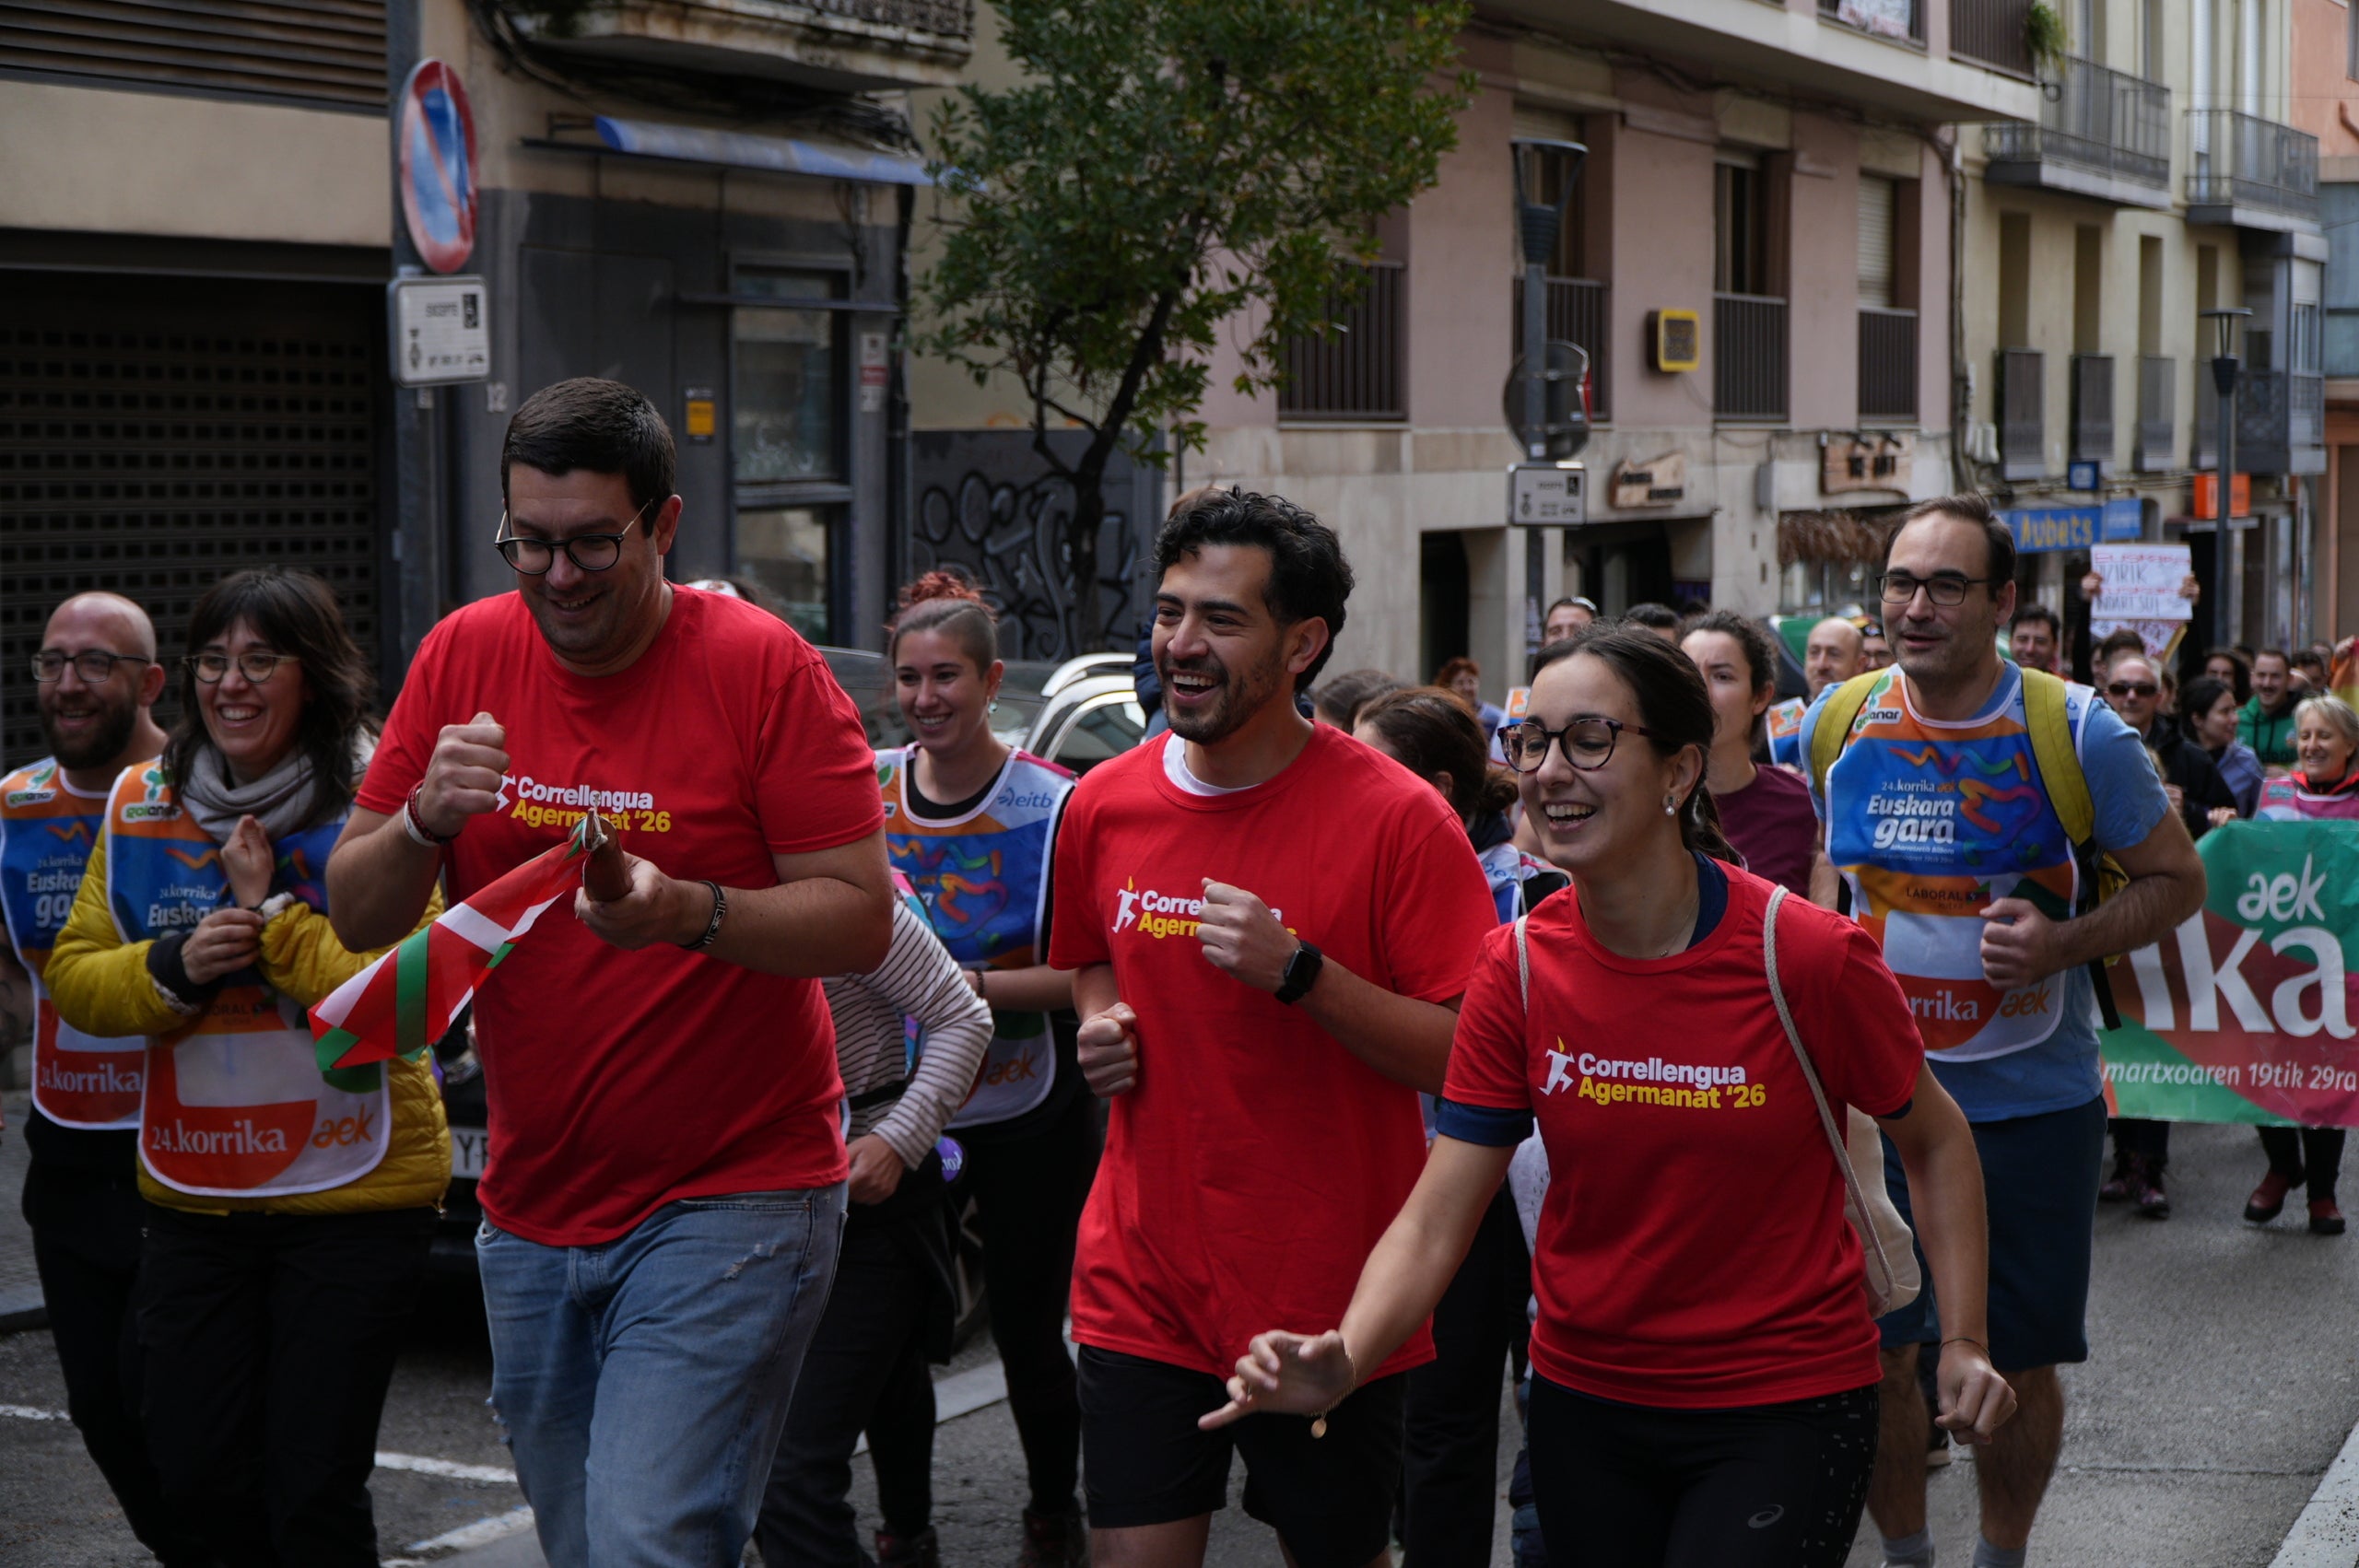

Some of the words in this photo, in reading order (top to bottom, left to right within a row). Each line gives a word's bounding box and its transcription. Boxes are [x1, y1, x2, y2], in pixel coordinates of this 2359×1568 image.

[2019, 513, 2094, 547] Aubets
[517, 776, 653, 813] Correllengua
[1882, 779, 1935, 793] 24.korrika
[511, 799, 630, 832] Agermat
[1867, 794, 1954, 817] Euskara
[1872, 819, 1954, 850] gara
[26, 870, 84, 894] Euska
[1906, 887, 1963, 902] LABORAL
[2236, 853, 2326, 923] aek
[35, 894, 73, 930] ga
[147, 901, 211, 928] Euska
[1141, 891, 1281, 924] Correa
[1909, 991, 1978, 1022] rrika
[2001, 980, 2049, 1019] aek
[41, 1061, 142, 1094] 24.korrika
[987, 1050, 1037, 1084] aek
[1579, 1052, 1746, 1091] Correllengua
[2104, 1060, 2240, 1086] martxoaren
[2248, 1061, 2303, 1089] 19tik
[2309, 1067, 2357, 1092] 29ra
[1578, 1076, 1721, 1109] Agermanat
[151, 1118, 288, 1155] 24.korrika
[313, 1105, 374, 1149] aek
